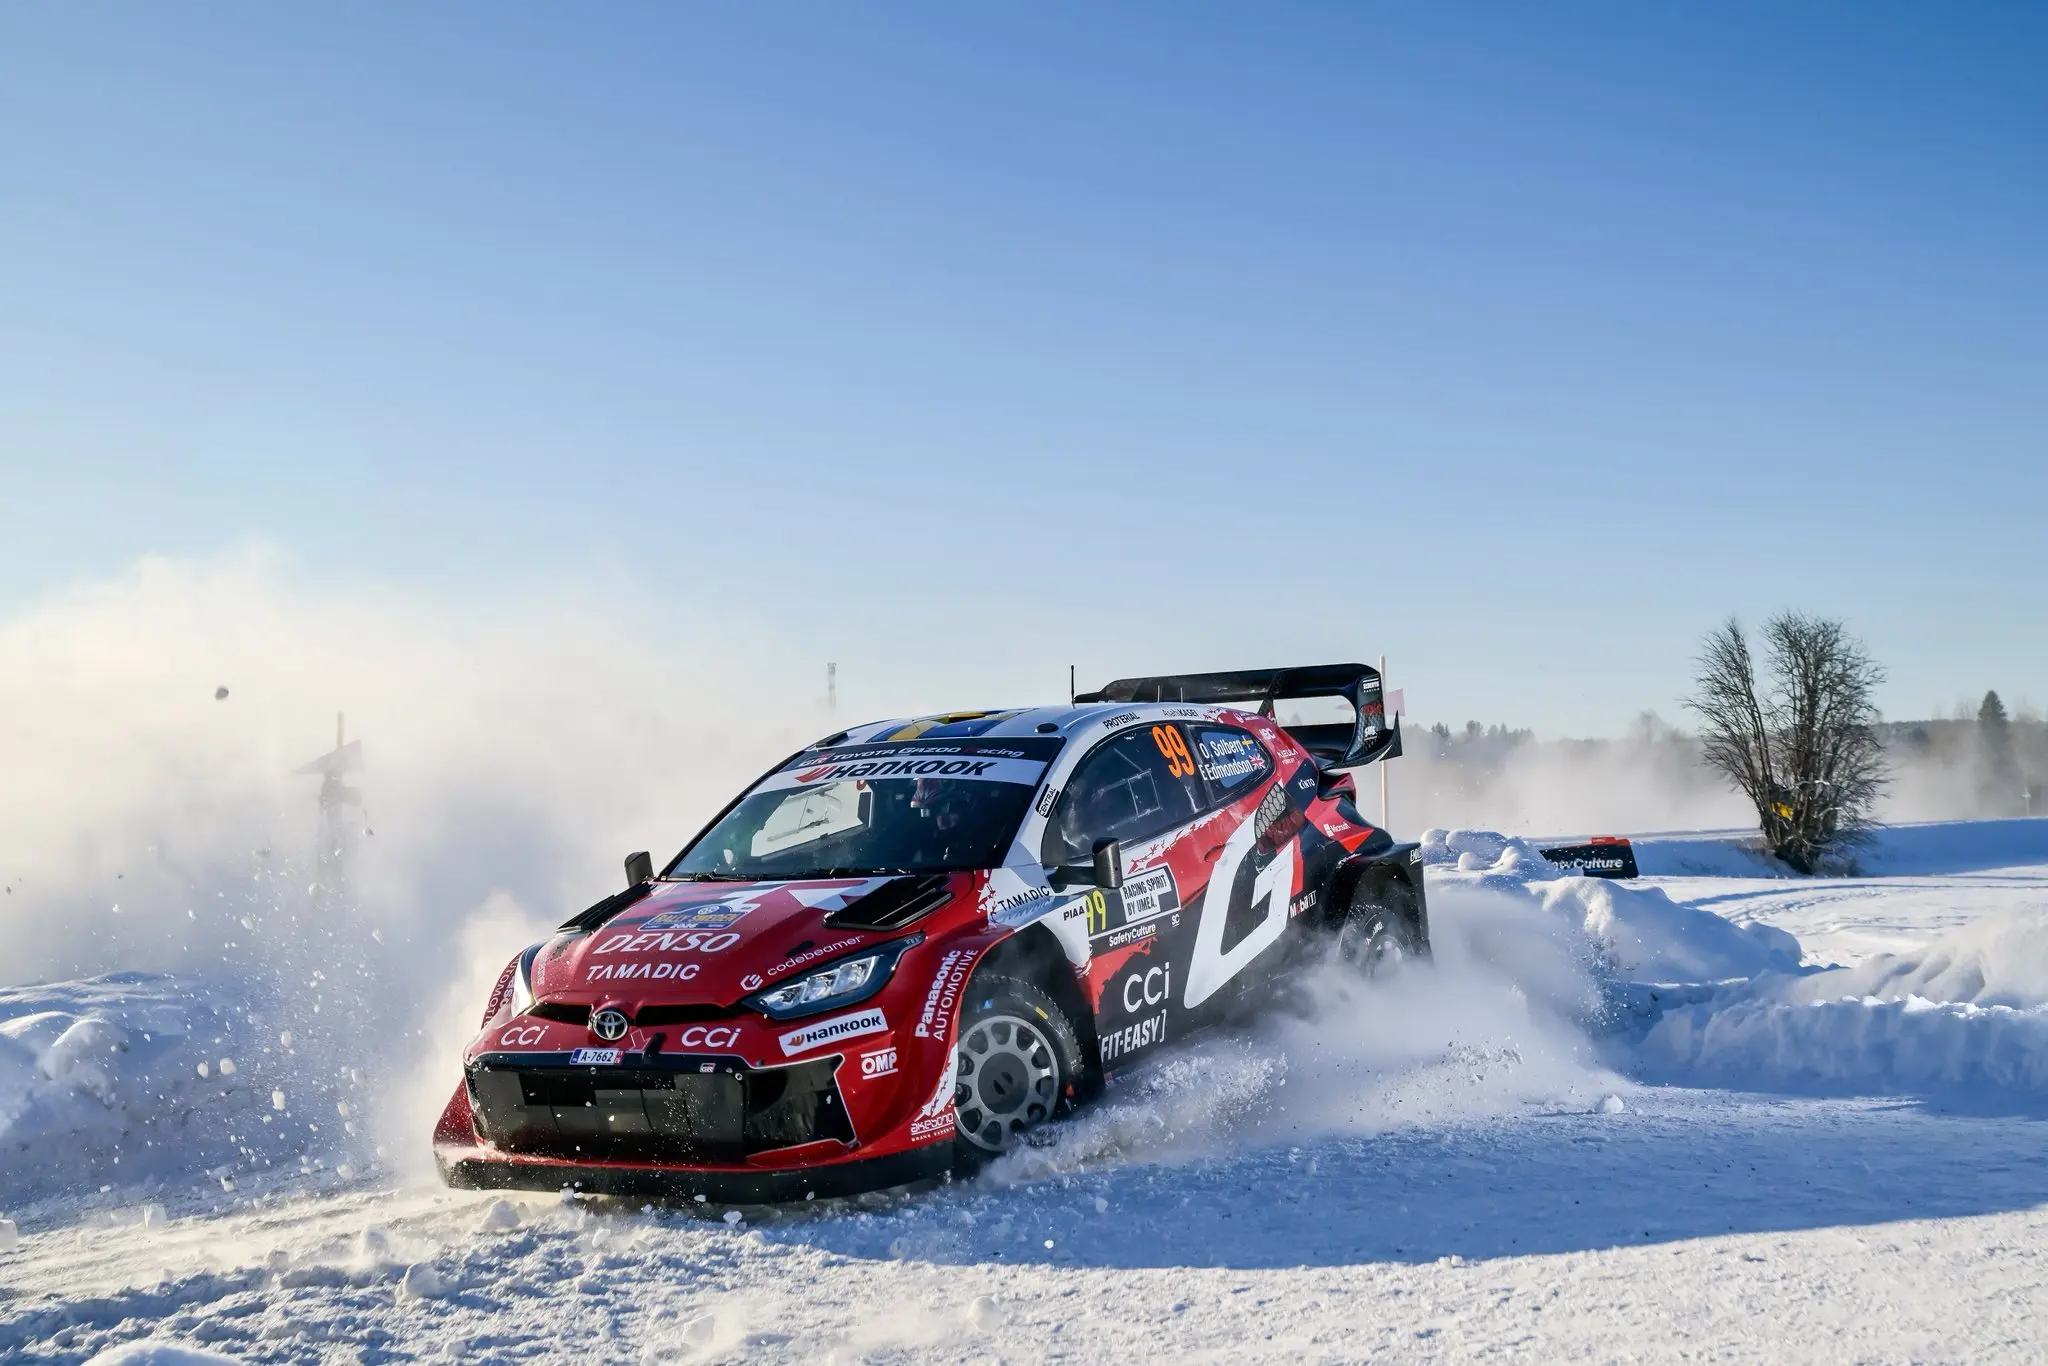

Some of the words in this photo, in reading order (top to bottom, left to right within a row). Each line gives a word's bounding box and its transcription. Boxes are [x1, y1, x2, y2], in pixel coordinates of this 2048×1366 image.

[1102, 711, 1140, 729] PROTERIAL
[832, 749, 896, 760] TOYOTA
[898, 747, 961, 755] GAZOO
[1152, 725, 1195, 778] 99
[1199, 742, 1213, 759] O.
[1210, 739, 1245, 756] Solberg
[1204, 758, 1254, 780] Edmondson
[1039, 787, 1057, 817] CENTRAL
[997, 885, 1050, 911] TAMADIC
[1122, 880, 1148, 900] RACING
[1147, 874, 1168, 893] SPIRIT
[1063, 905, 1086, 921] PIAA
[1084, 889, 1107, 934] 99
[1126, 901, 1136, 916] BY
[592, 932, 741, 954] DENSO
[1109, 923, 1156, 946] SafetyCulture
[586, 963, 700, 980] TAMADIC
[914, 949, 962, 1038] Panasonic
[932, 949, 979, 1041] AUTOMOTIVE
[1098, 1009, 1167, 1063] FIT-EASY]
[580, 1050, 614, 1062] A-7662
[861, 1051, 898, 1074] OMP
